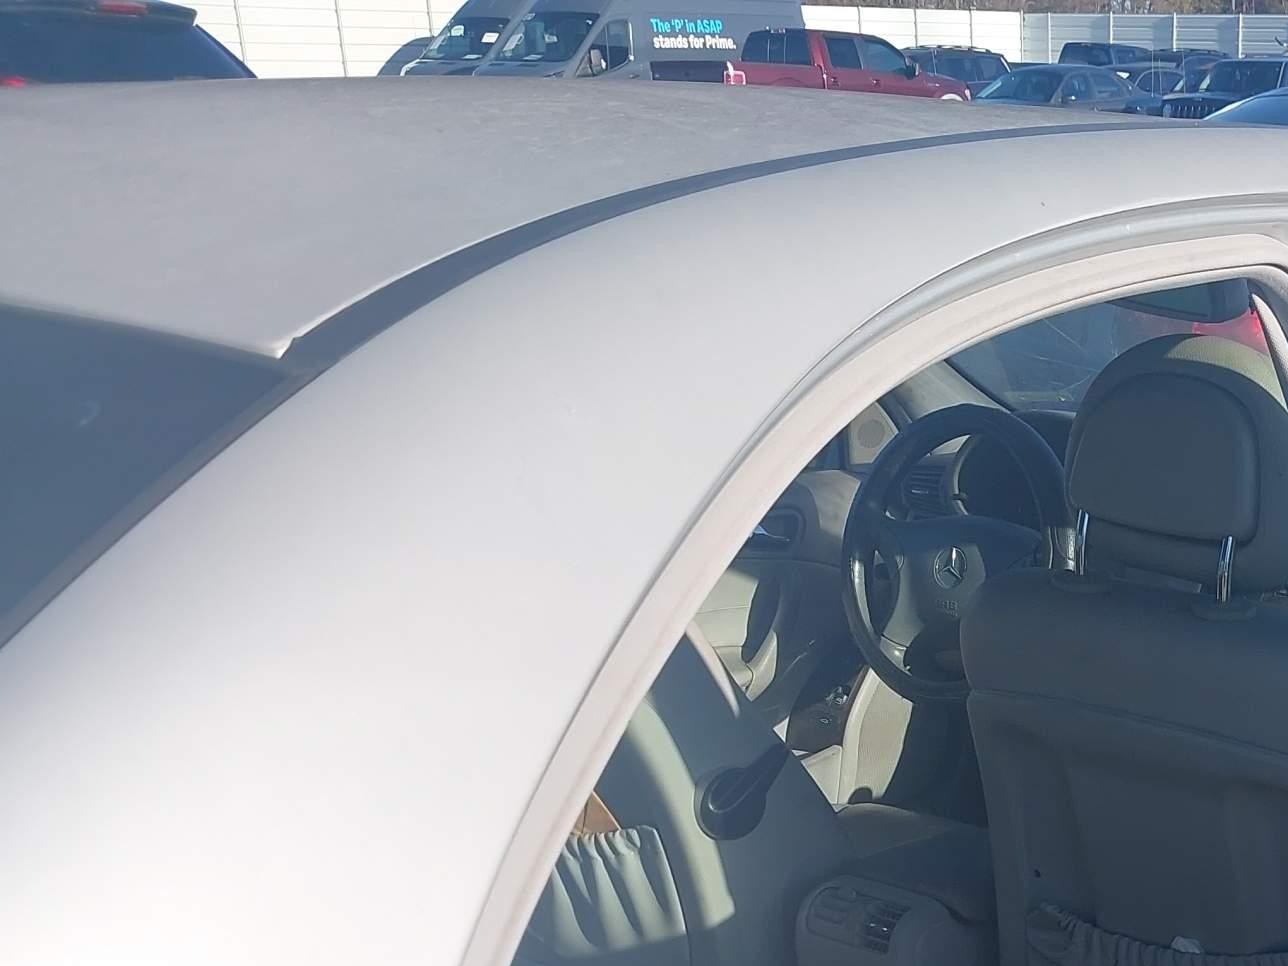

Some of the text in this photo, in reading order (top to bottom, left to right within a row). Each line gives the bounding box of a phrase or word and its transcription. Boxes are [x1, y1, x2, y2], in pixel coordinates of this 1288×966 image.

[650, 18, 671, 33] The
[685, 19, 696, 33] in
[697, 19, 723, 34] ASAP
[653, 34, 736, 50] stands for Prime.
